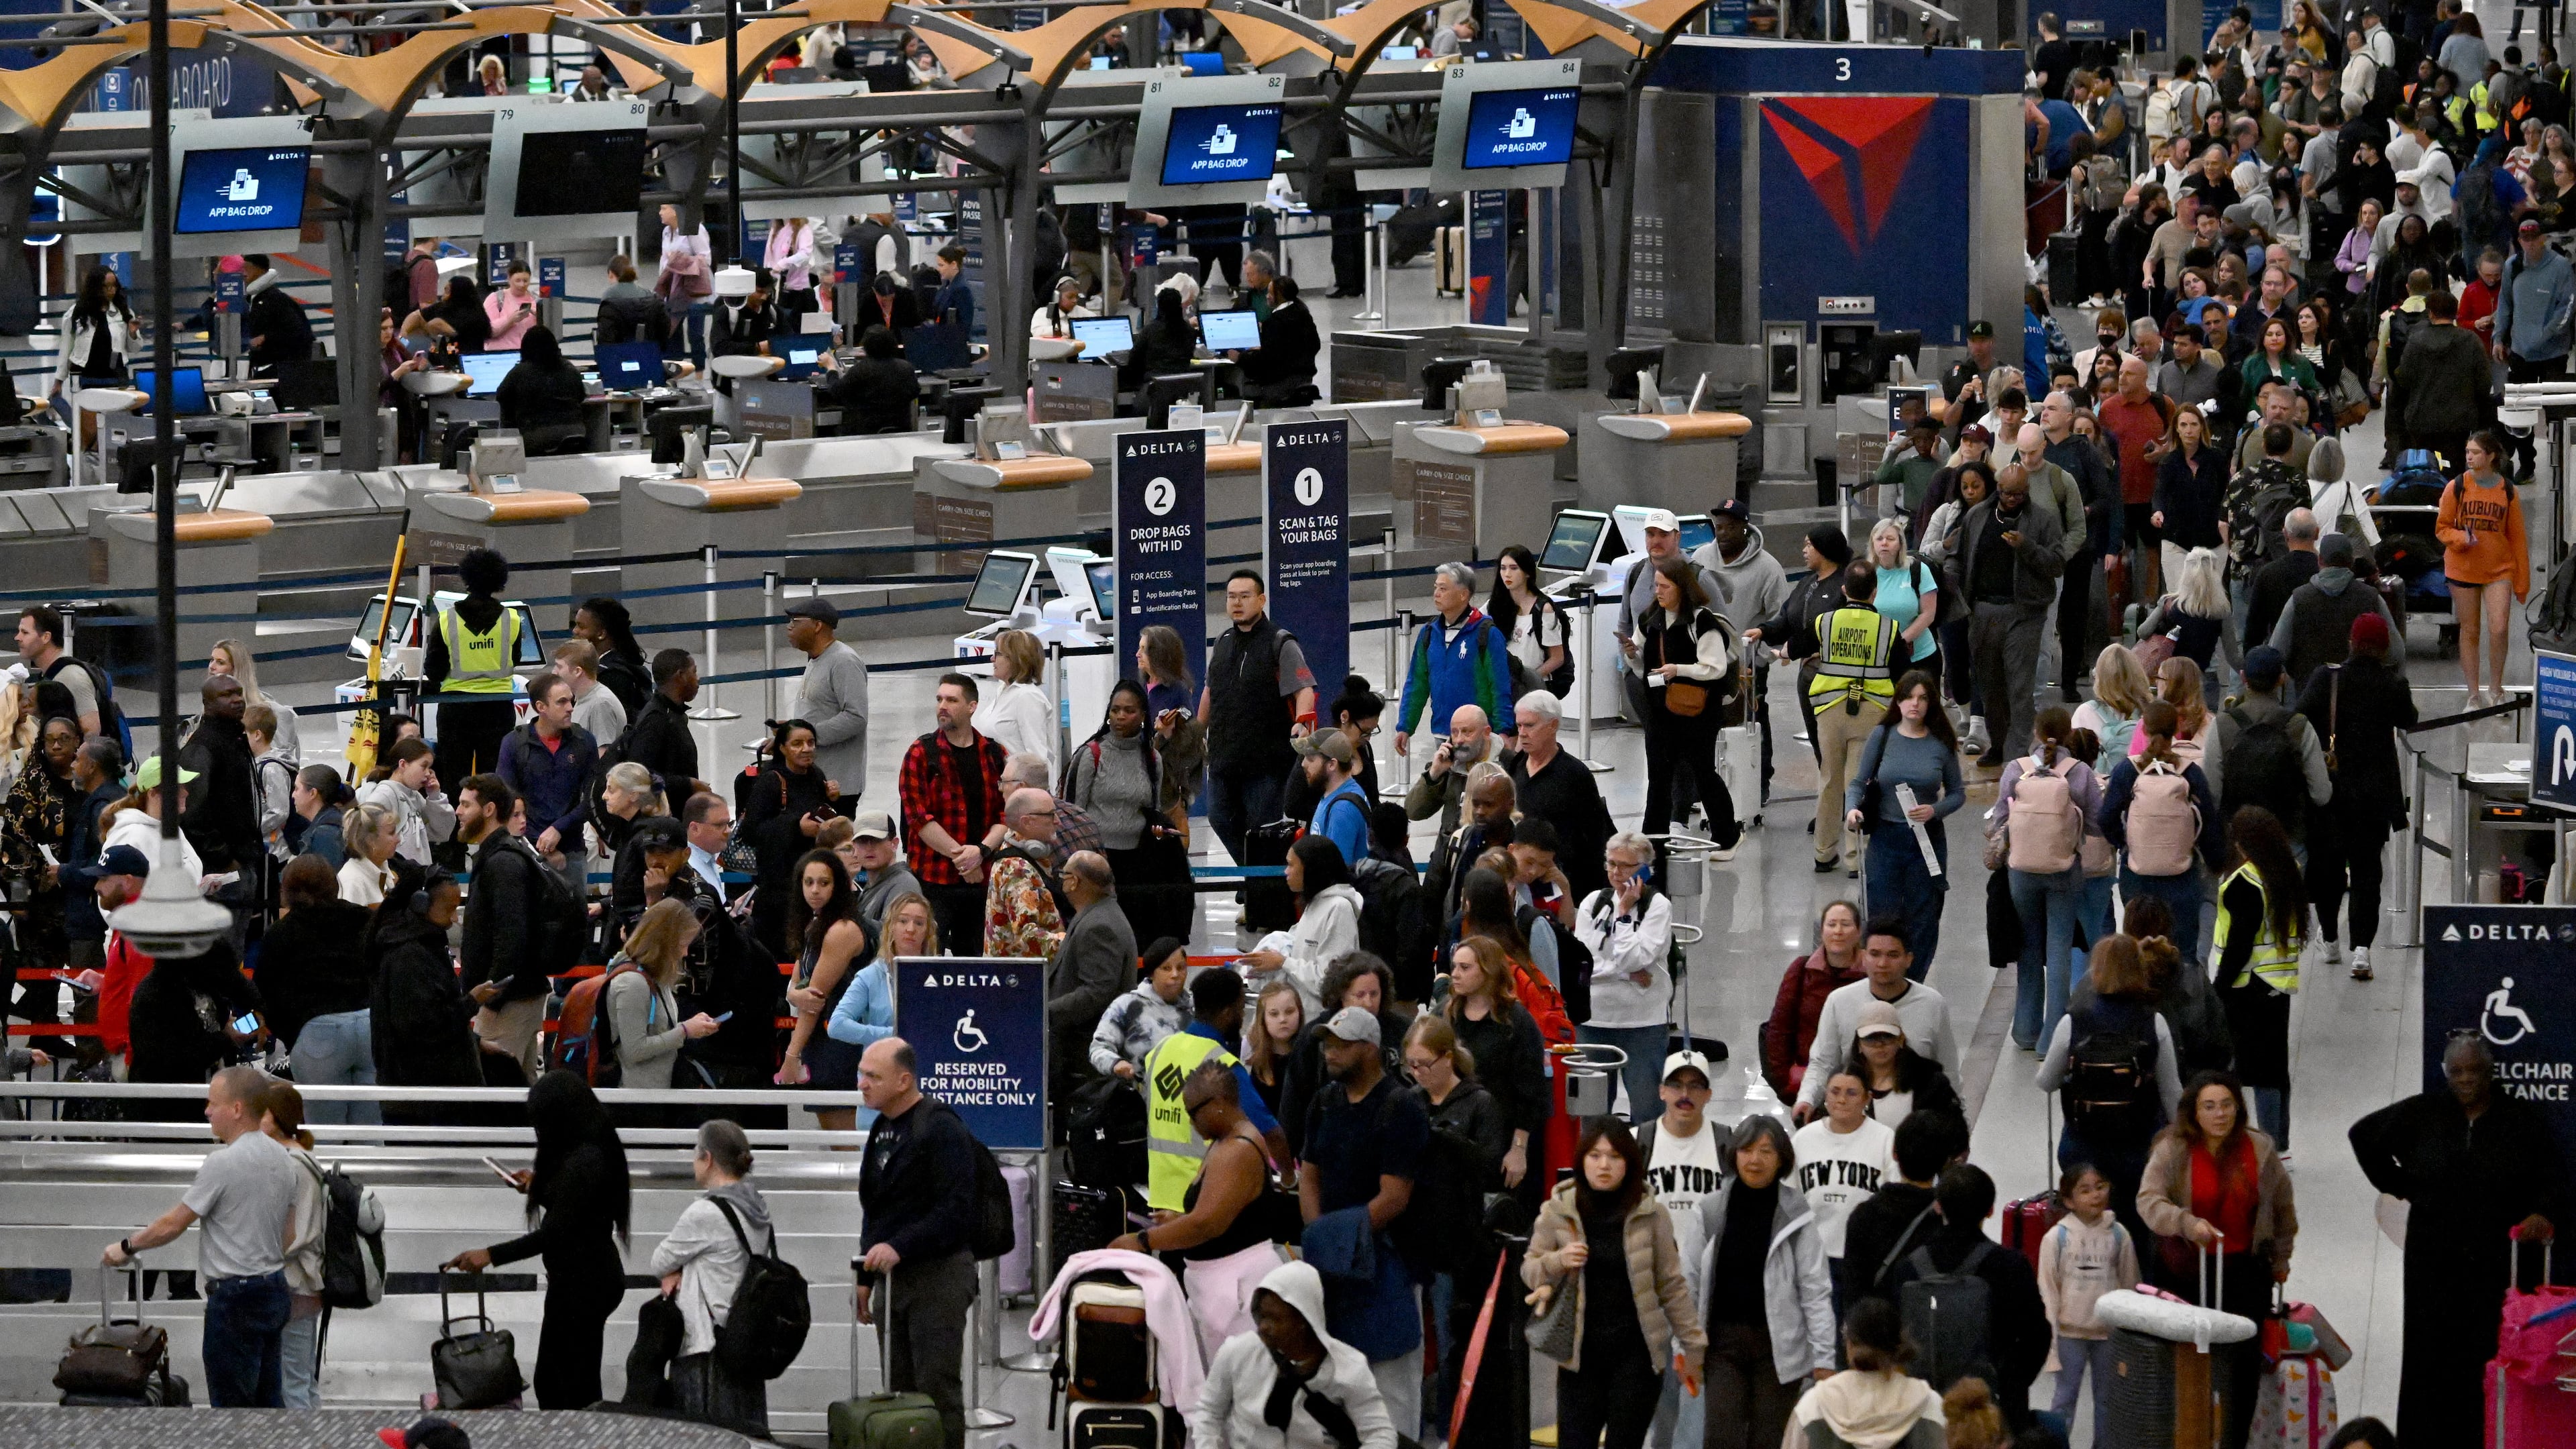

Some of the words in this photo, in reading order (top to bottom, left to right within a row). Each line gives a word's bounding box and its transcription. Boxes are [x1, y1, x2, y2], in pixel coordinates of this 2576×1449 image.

[1452, 68, 1464, 78] 83
[1562, 63, 1575, 72] 84
[1835, 58, 1851, 80] 3
[1150, 82, 1162, 93] 81
[1269, 77, 1281, 87] 82
[500, 109, 514, 120] 79
[631, 103, 645, 114] 80
[168, 125, 176, 136] 7
[1492, 144, 1507, 153] APP
[1509, 143, 1525, 152] BAG
[1525, 142, 1547, 151] DROP
[1191, 160, 1208, 169] APP
[1208, 159, 1225, 168] BAG
[1226, 158, 1248, 167] DROP
[209, 207, 227, 217] APP
[227, 206, 246, 217] BAG
[248, 205, 272, 215] DROP
[1289, 433, 1329, 445] DELTA
[1140, 443, 1183, 455] DELTA
[1416, 470, 1442, 478] CARRY-ON
[1304, 475, 1311, 498] 1
[1154, 484, 1167, 508] 2
[938, 504, 963, 514] CARRY-ON
[2461, 500, 2506, 520] AUBURN
[1279, 517, 1306, 530] SCAN
[1308, 517, 1316, 528] &
[1318, 515, 1338, 527] TAG
[1130, 527, 1160, 540] DROP
[1163, 525, 1191, 538] BAGS
[1281, 531, 1309, 544] YOUR
[1311, 529, 1337, 541] BAGS
[1139, 541, 1169, 553] WITH
[1171, 540, 1183, 551] ID
[1315, 560, 1336, 568] boarding
[1130, 573, 1144, 581] FOR
[1145, 570, 1173, 580] ACCESS:
[1290, 580, 1302, 588] tags.
[1159, 590, 1182, 598] Boarding
[1146, 604, 1181, 612] Identification
[1182, 602, 1198, 610] Ready
[1838, 627, 1868, 643] AIRPORT
[470, 638, 494, 650] unifi
[1831, 641, 1872, 659] OPERATIONS
[2469, 924, 2551, 940] DELTA
[943, 975, 1001, 986] DELTA
[935, 1063, 1006, 1075] RESERVED
[2491, 1063, 2573, 1079] ELCHAIR
[920, 1078, 948, 1089] FOR
[952, 1078, 1022, 1090] MOBILITY
[2501, 1084, 2570, 1101] TANCE
[997, 1093, 1036, 1106] ONLY
[1155, 1106, 1181, 1124] unifi
[1648, 1165, 1676, 1195] EW
[1837, 1160, 1882, 1193] YORK
[1824, 1193, 1847, 1203] CITY
[1668, 1201, 1694, 1210] CITY
